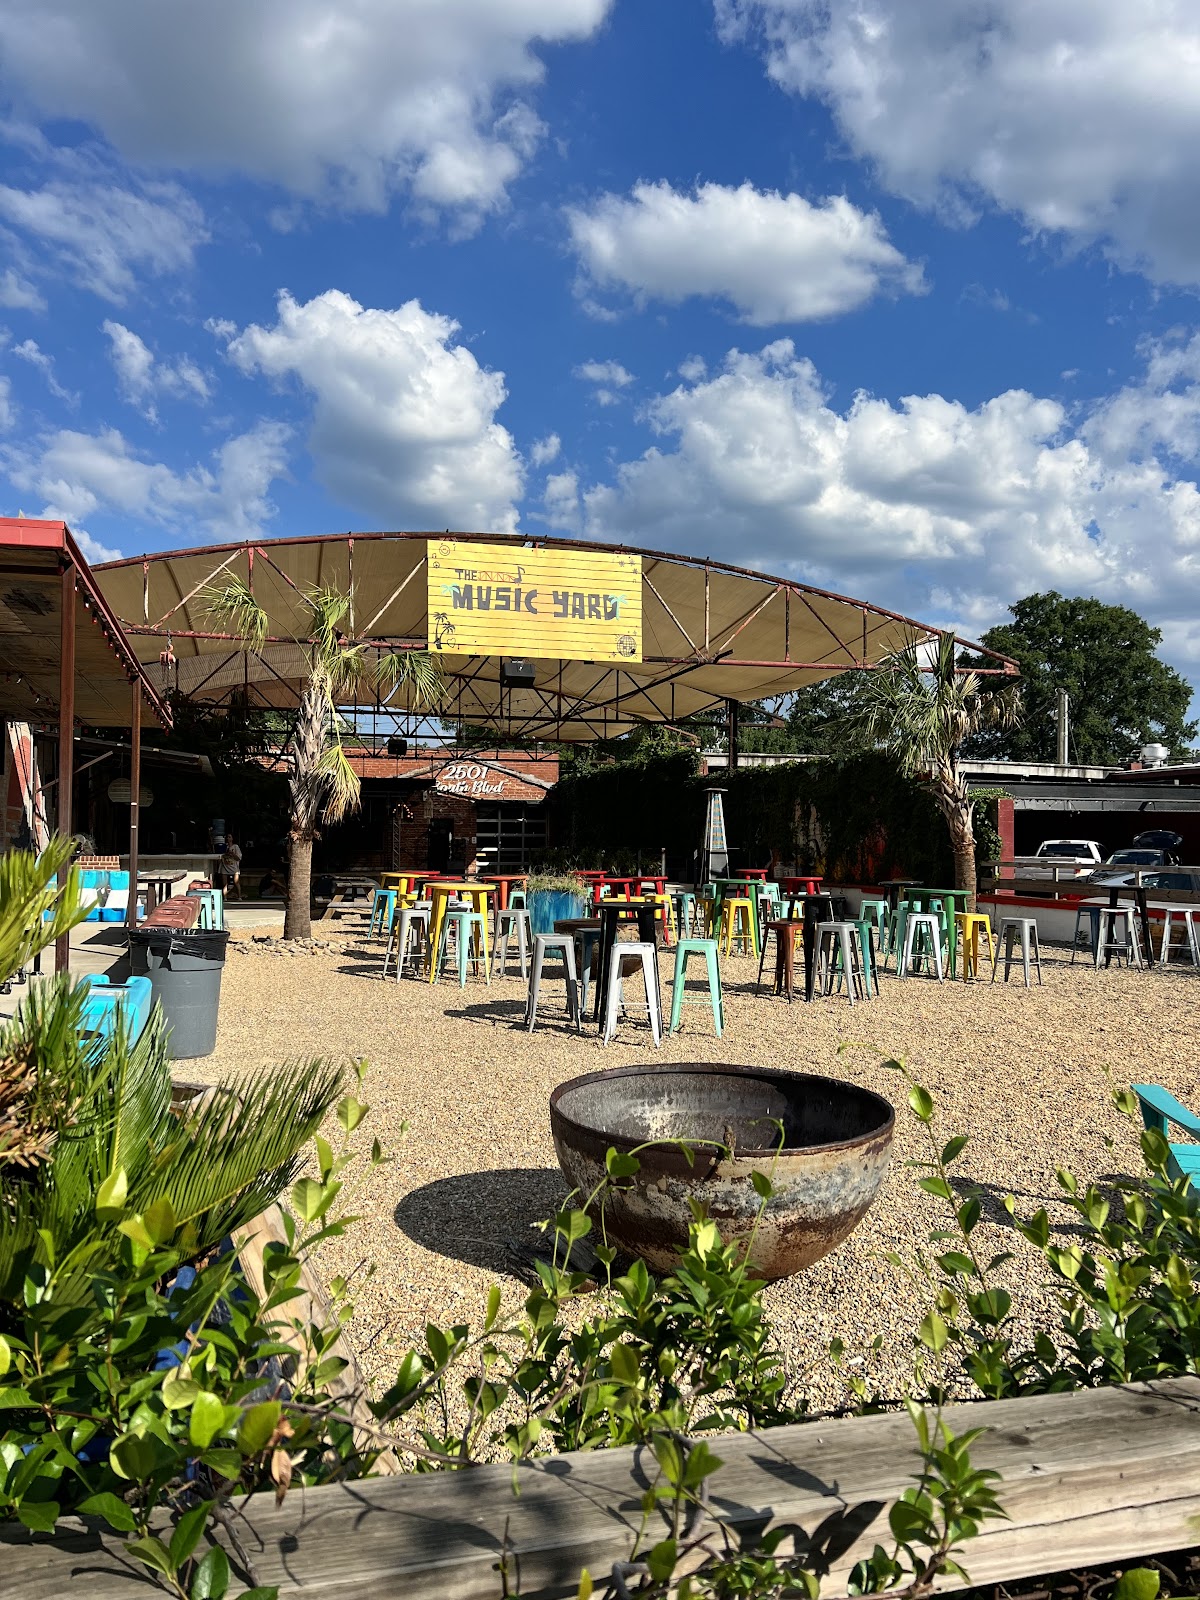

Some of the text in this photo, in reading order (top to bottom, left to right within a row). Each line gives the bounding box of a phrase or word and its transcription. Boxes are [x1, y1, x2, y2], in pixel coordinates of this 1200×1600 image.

[455, 569, 478, 581] THE
[452, 584, 619, 621] MUSIC YARD
[443, 765, 489, 780] 2501
[471, 779, 507, 794] Blvd
